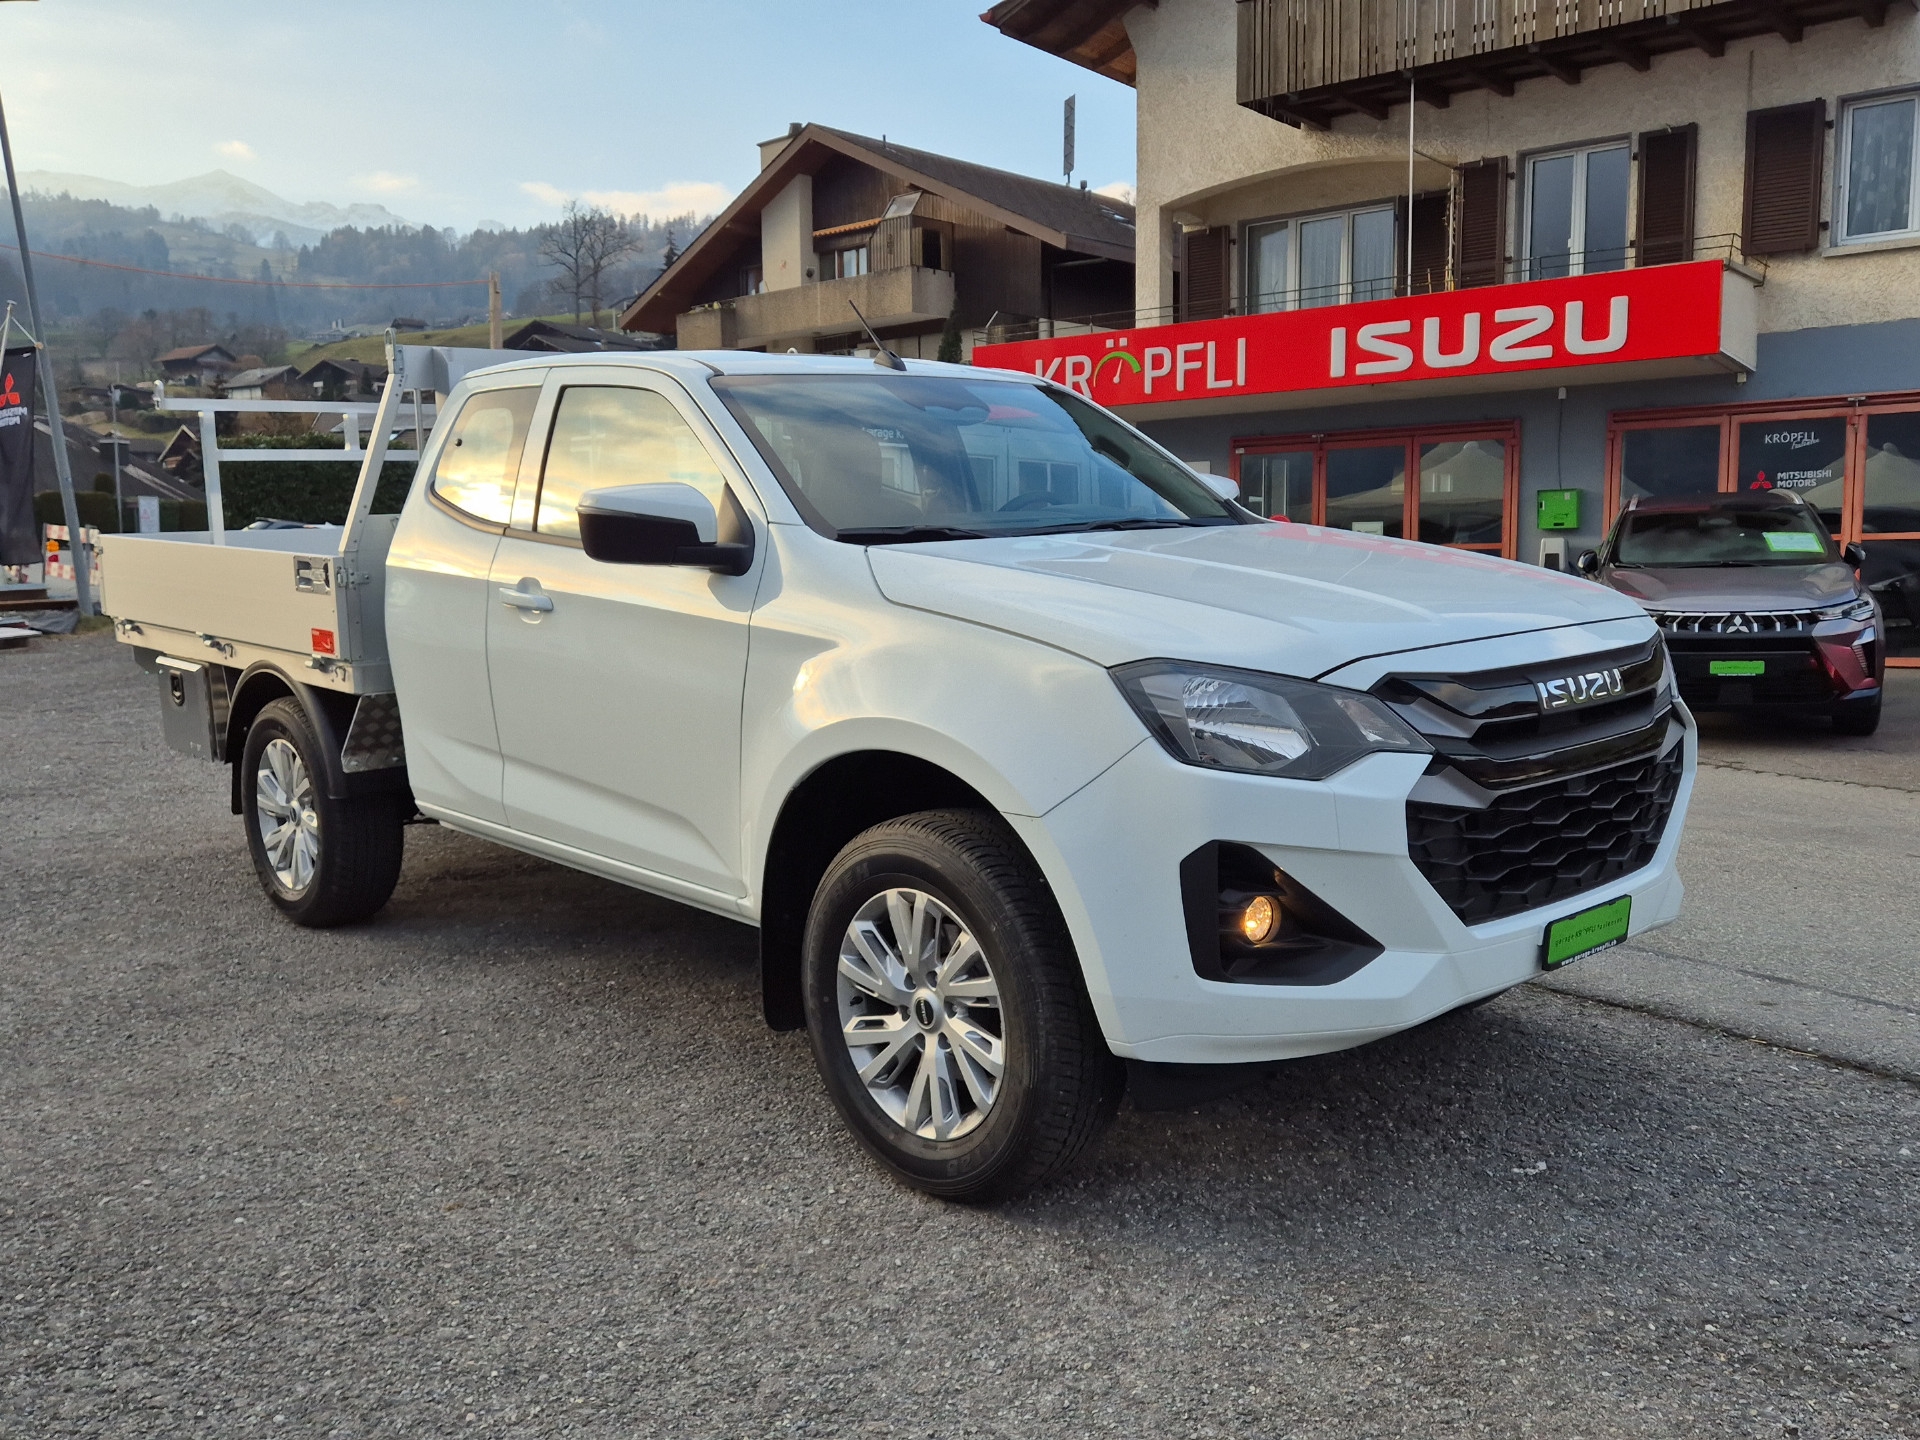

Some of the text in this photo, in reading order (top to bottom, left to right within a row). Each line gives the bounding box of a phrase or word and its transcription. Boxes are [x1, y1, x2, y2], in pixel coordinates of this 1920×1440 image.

[1330, 295, 1629, 378] ISUZU
[1764, 431, 1815, 444] KRÖPFLI
[1777, 470, 1832, 480] MITSUBISHI
[1777, 479, 1817, 488] MOTORS
[1537, 668, 1624, 710] ISUZU
